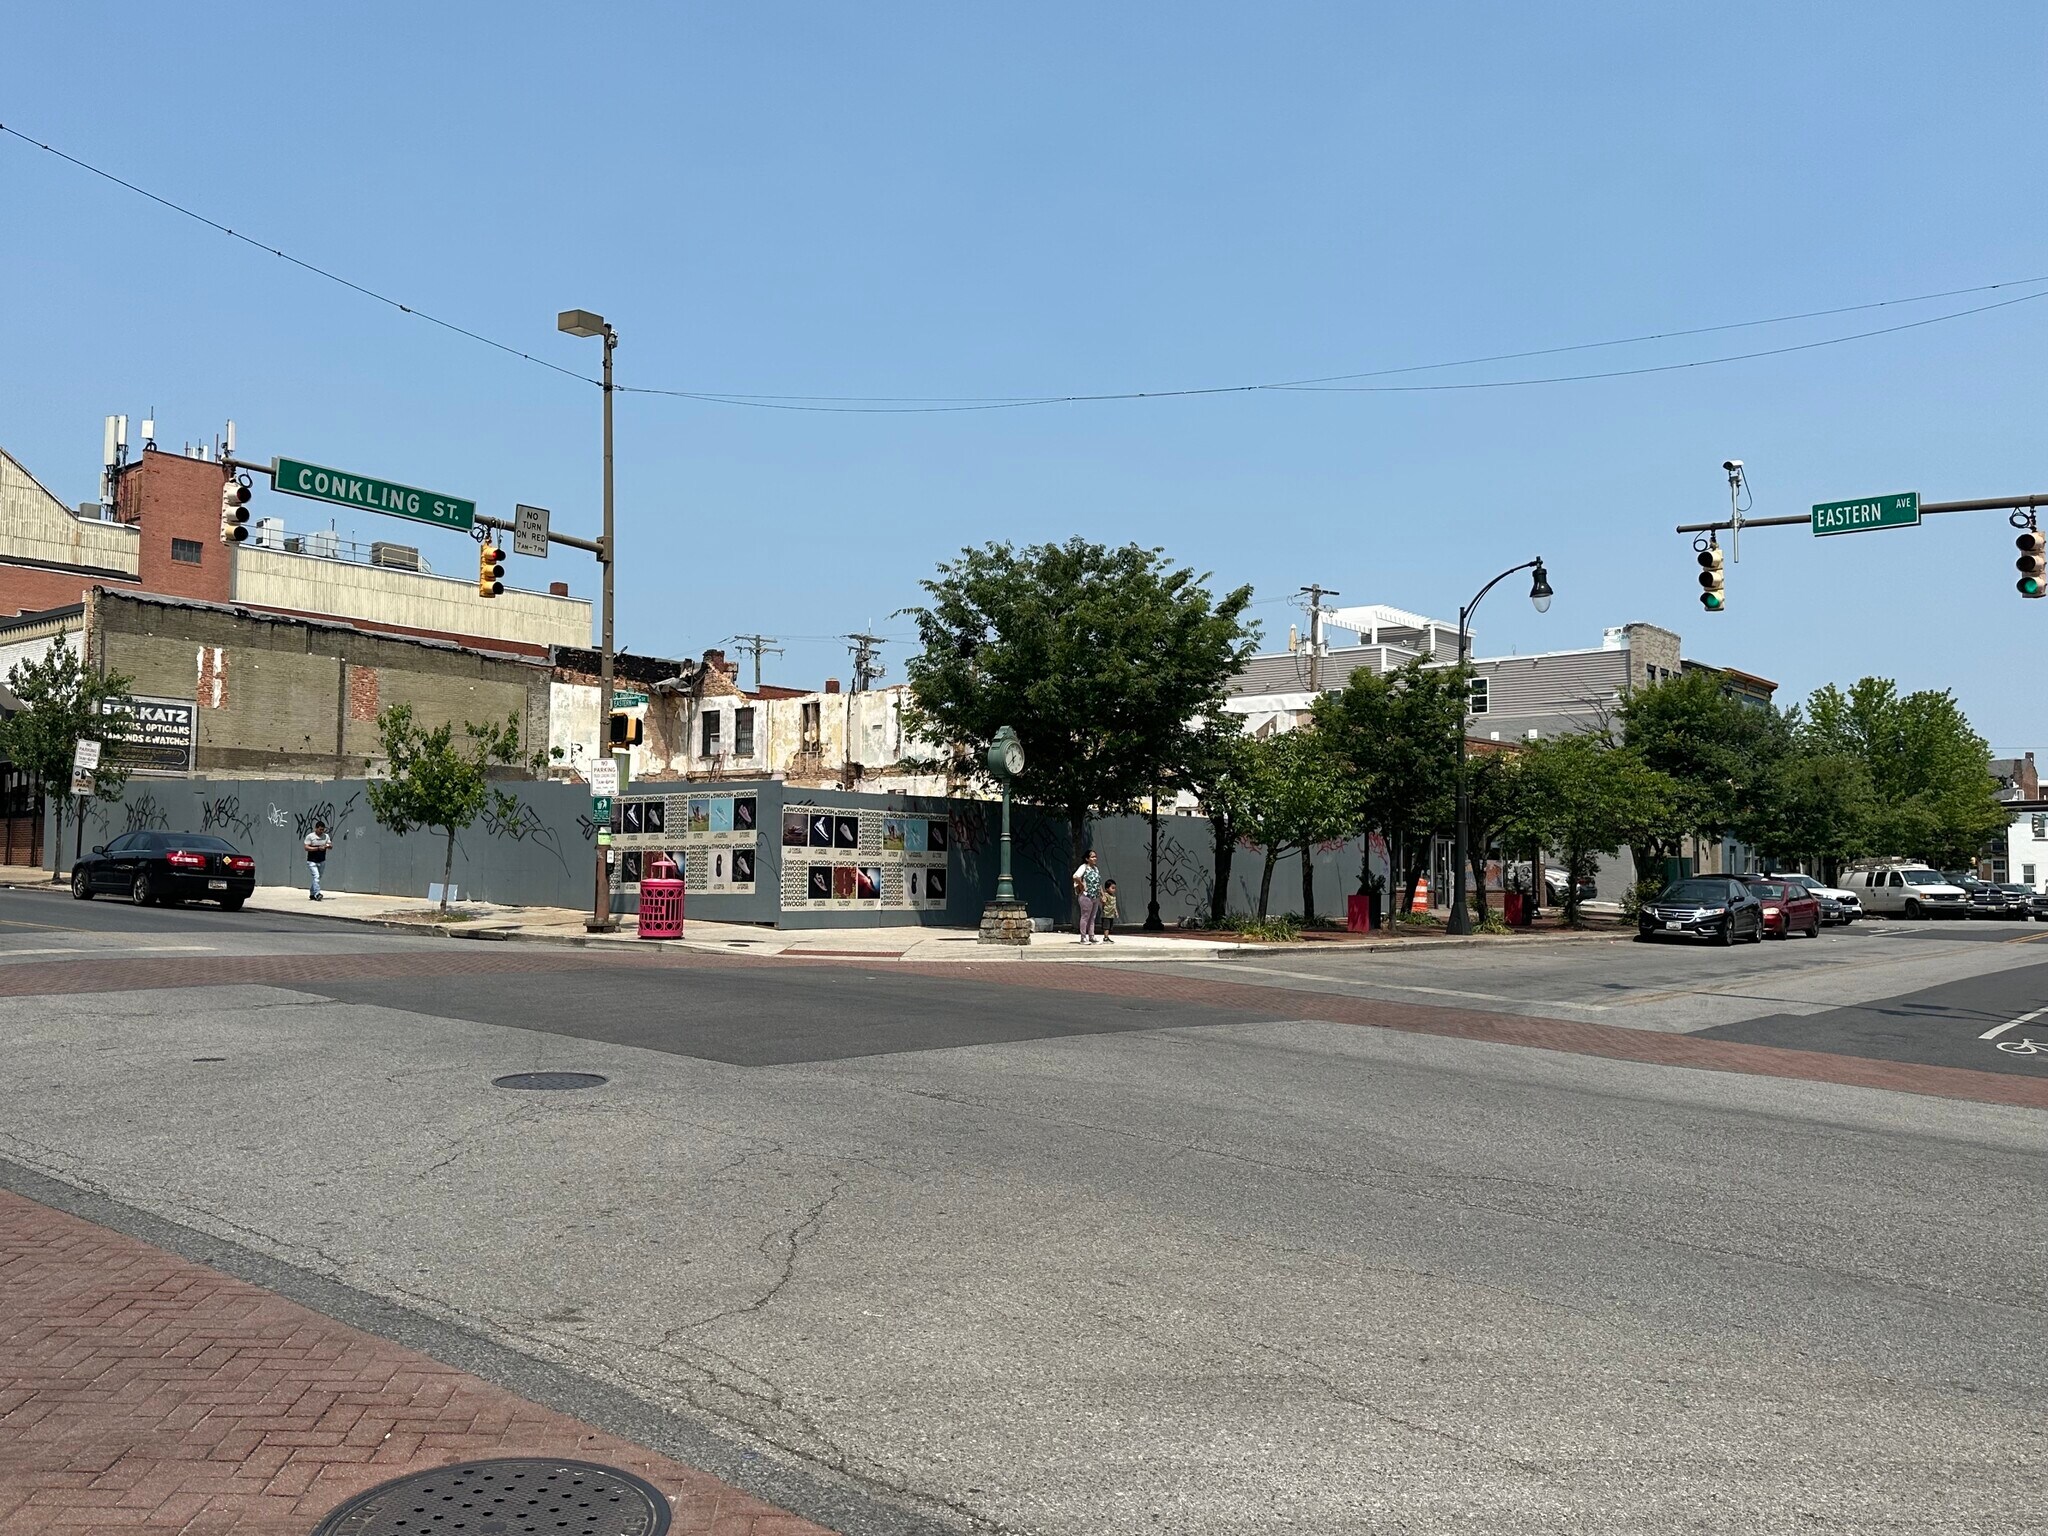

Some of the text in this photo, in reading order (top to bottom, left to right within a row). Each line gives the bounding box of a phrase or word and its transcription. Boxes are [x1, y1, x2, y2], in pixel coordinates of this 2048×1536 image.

[298, 468, 460, 520] CONKLING ST.
[526, 512, 538, 520] NO
[1818, 498, 1911, 527] EASTERN AVE
[523, 521, 542, 531] TURN
[516, 530, 546, 542] ON RED
[140, 706, 189, 723] KATZ
[146, 723, 190, 735] OPTICIANS
[152, 735, 190, 746] WATCHES
